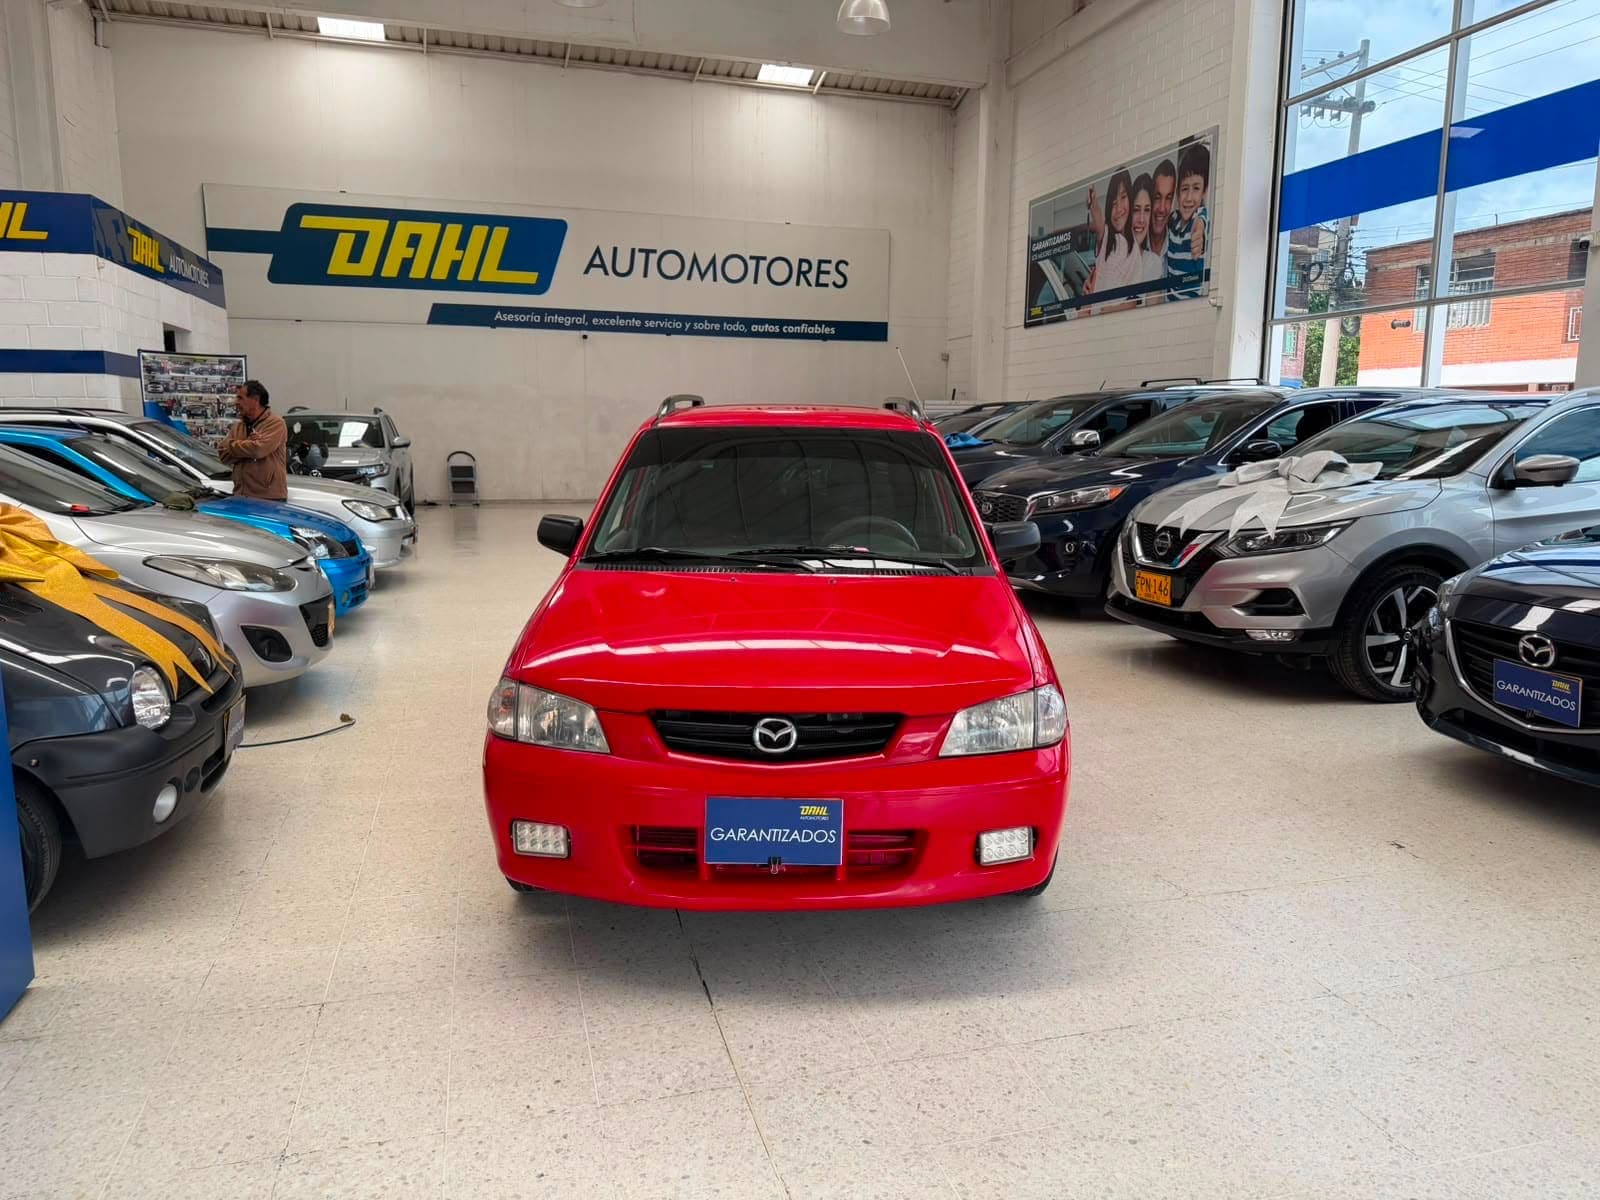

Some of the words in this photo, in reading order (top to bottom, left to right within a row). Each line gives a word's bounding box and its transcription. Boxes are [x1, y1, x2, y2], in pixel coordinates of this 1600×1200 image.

[300, 215, 539, 285] DAHL
[583, 245, 849, 289] AUTOMOTORES
[1031, 231, 1072, 252] GARANTIZAMOS
[127, 226, 165, 273] DAHL
[169, 252, 209, 289] AUTOMOTORES
[494, 311, 541, 323] Asesoría
[544, 313, 588, 327] integral,
[592, 315, 642, 327] excelente
[644, 318, 682, 329] servicio
[685, 321, 692, 331] y
[693, 319, 721, 331] sobre
[723, 321, 748, 333] todo,
[751, 323, 780, 333] autos
[782, 323, 836, 335] confiables
[1496, 680, 1577, 711] GARANTIZADOS
[799, 805, 829, 815] DAHL
[710, 827, 837, 843] GARANTIZADOS
